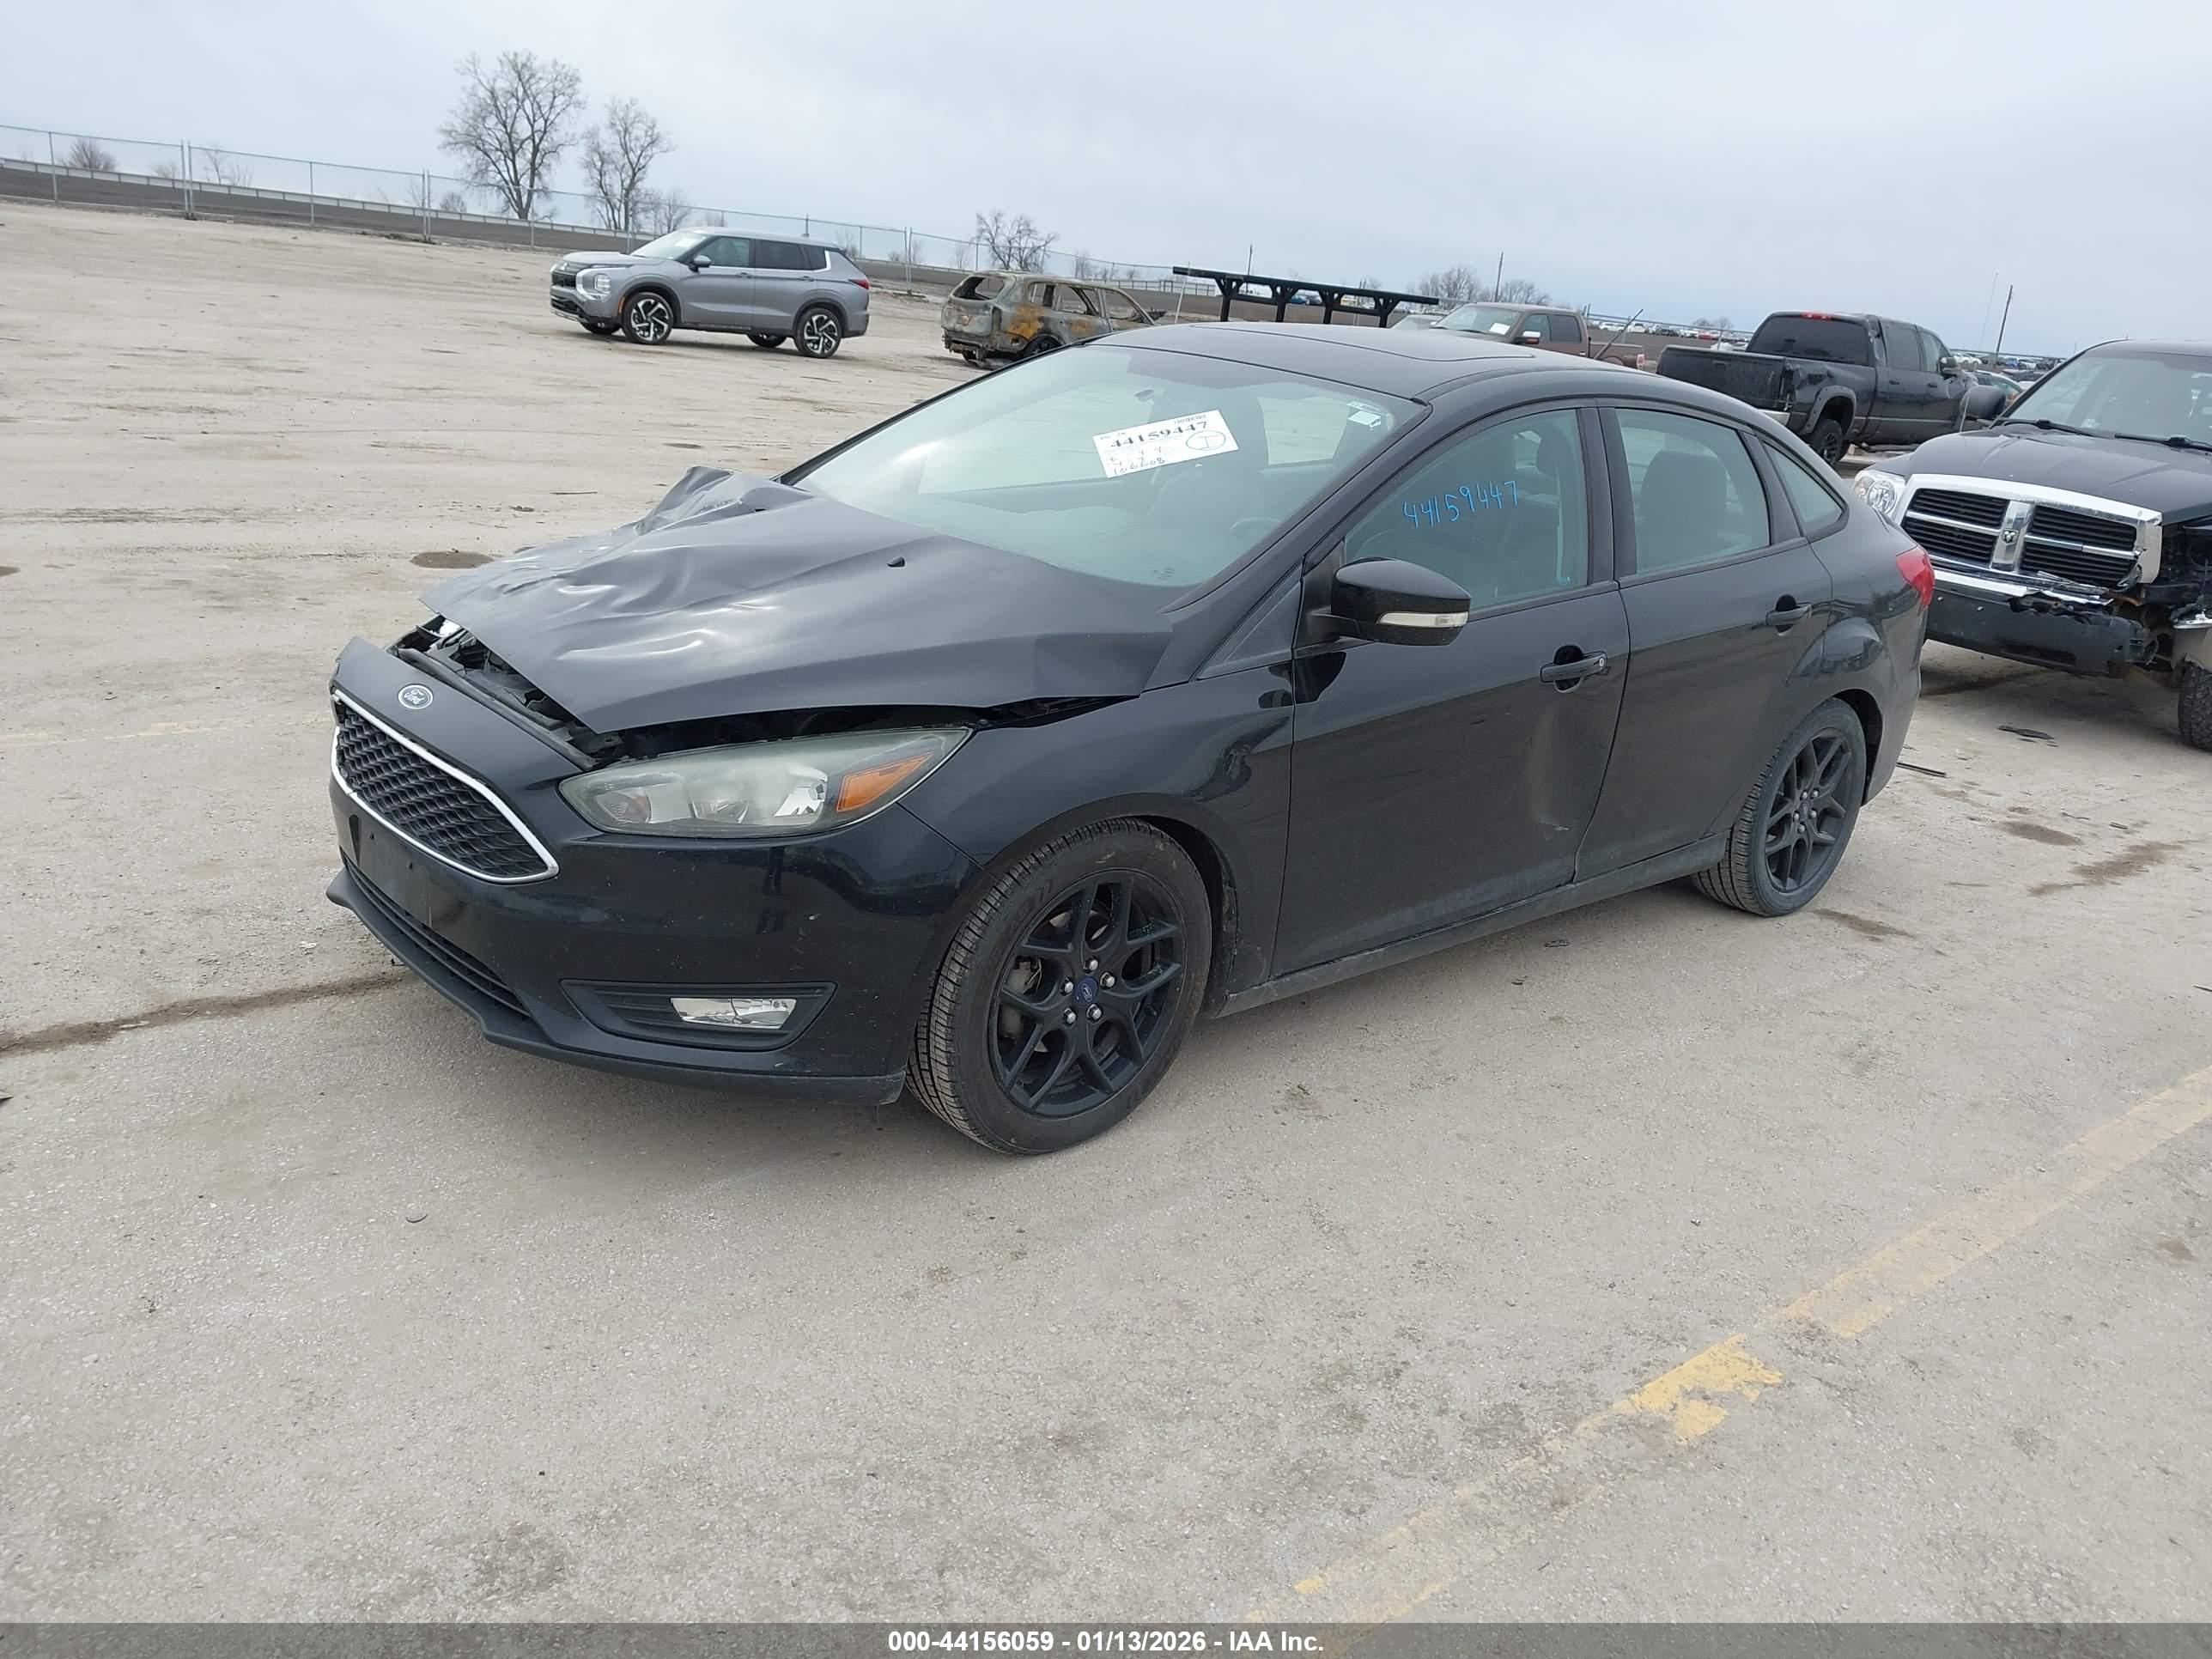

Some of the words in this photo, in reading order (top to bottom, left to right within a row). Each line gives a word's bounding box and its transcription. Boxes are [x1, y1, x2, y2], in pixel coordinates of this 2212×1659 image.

[1110, 420, 1208, 447] 44159447
[1402, 480, 1518, 528] 44159447
[404, 689, 426, 705] Ford
